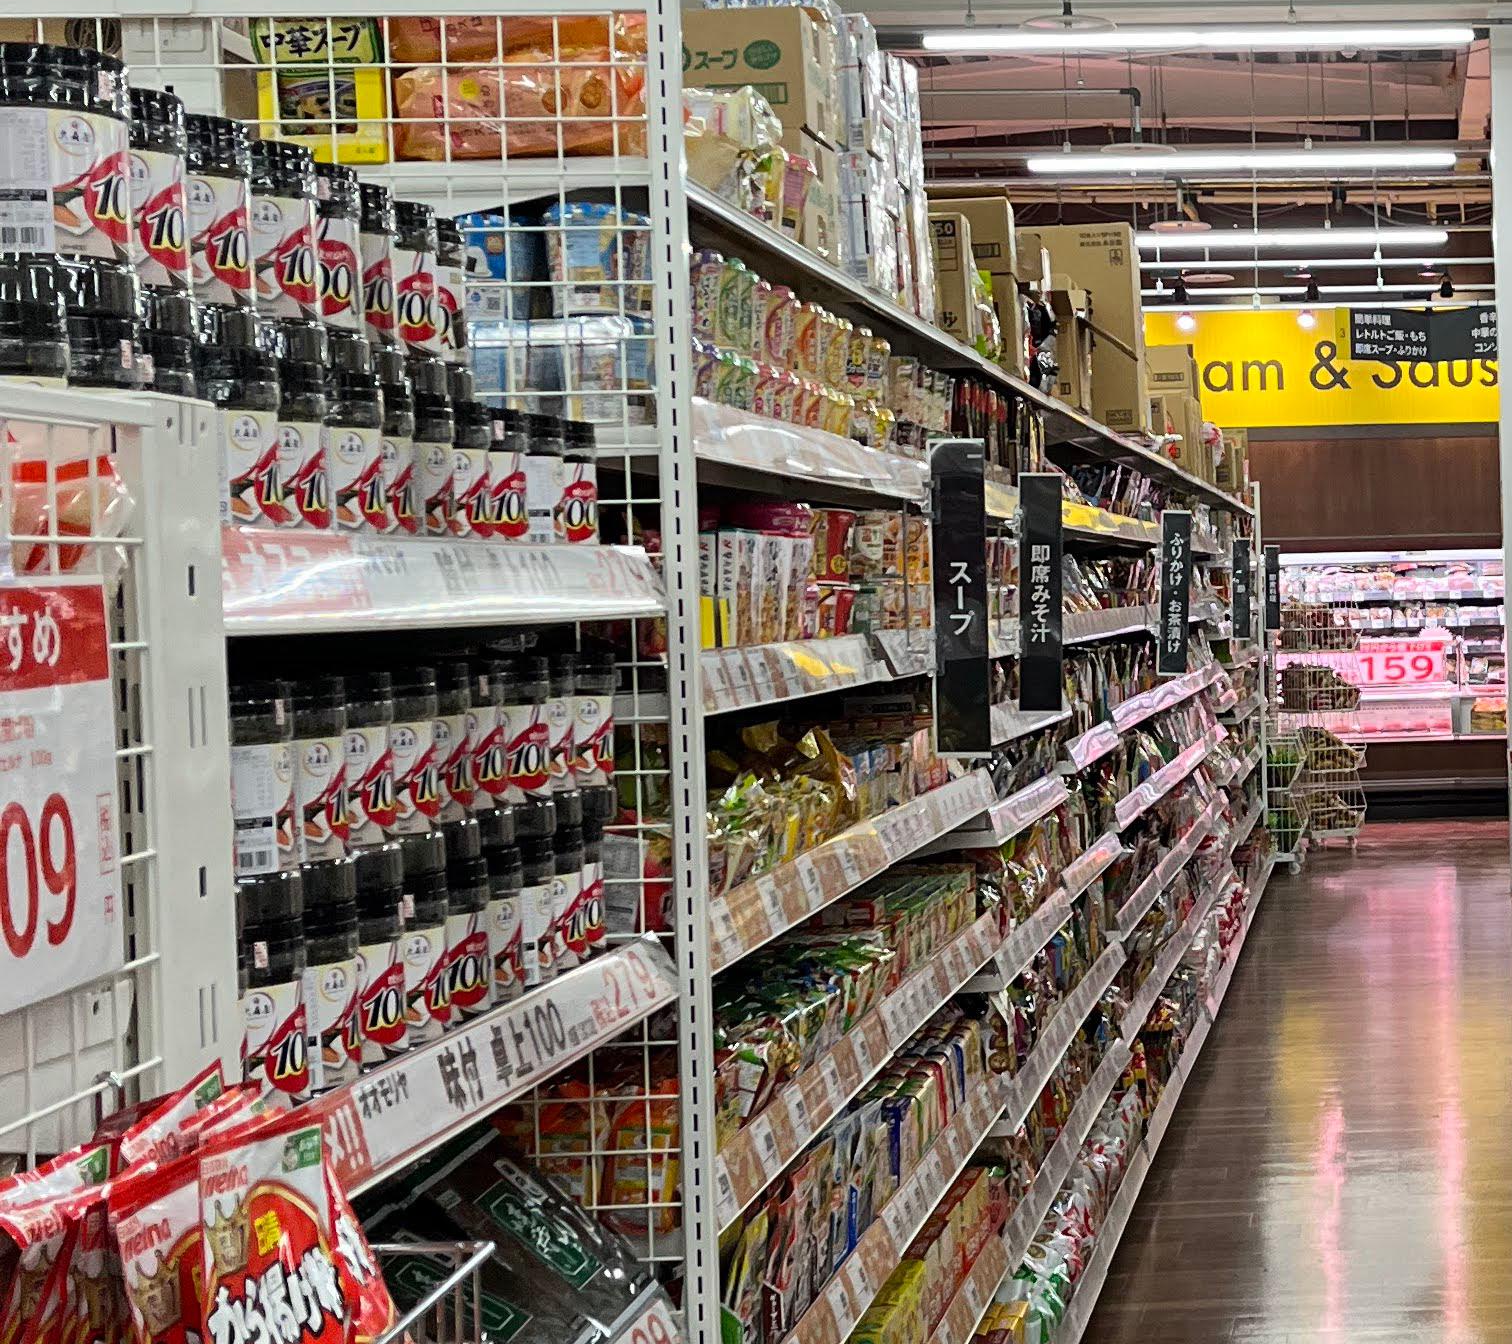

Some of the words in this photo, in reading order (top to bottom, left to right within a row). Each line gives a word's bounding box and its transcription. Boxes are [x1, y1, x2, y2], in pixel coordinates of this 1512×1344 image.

[259, 24, 367, 58] 中華スープ
[1203, 359, 1286, 394] am
[1309, 340, 1352, 391] &
[949, 562, 975, 635] スープ
[1030, 545, 1051, 643] 即席みそ汁
[1169, 532, 1185, 654] ふりかけ・お茶漬け
[1360, 655, 1434, 682] 159
[437, 1036, 484, 1111] 味付
[604, 951, 656, 1016] 279
